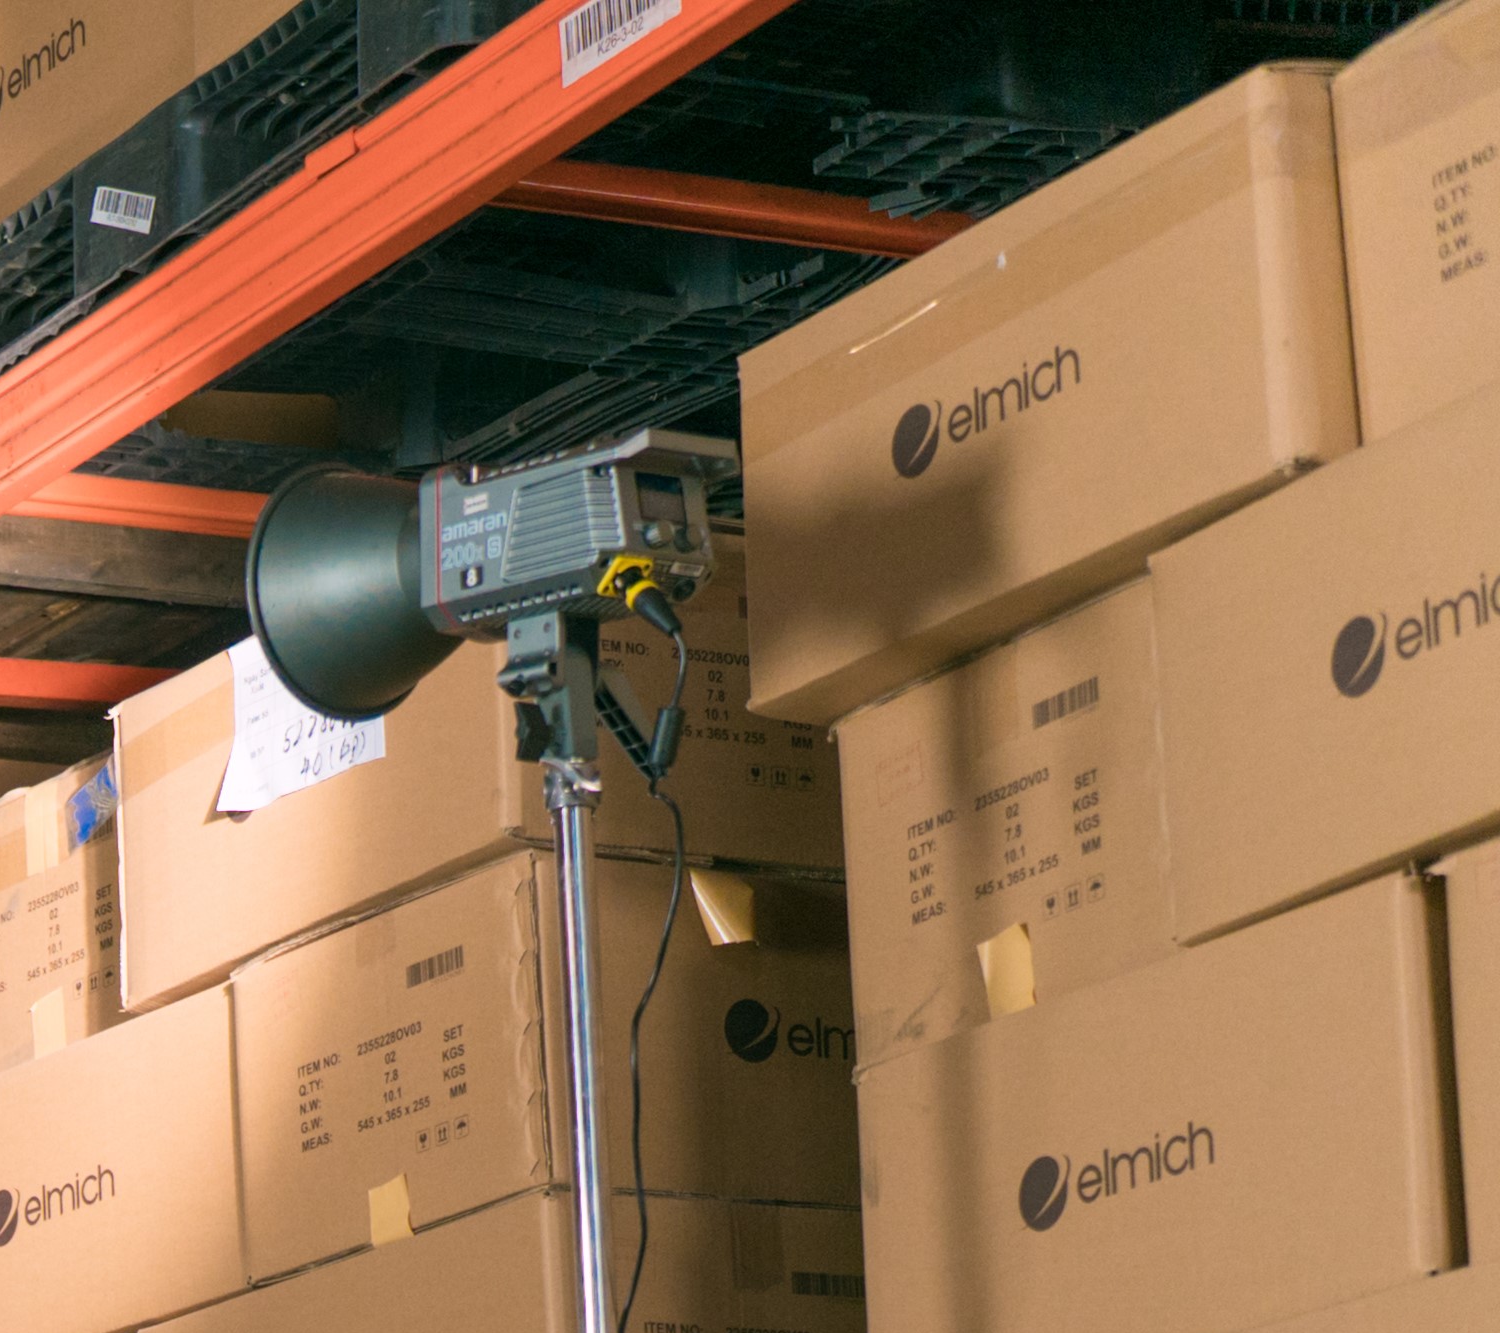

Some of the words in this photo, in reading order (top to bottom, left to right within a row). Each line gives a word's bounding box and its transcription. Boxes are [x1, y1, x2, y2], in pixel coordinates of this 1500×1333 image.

[8, 18, 86, 98] elmich
[597, 16, 644, 57] K26-3-02
[948, 346, 1080, 443] elmich
[441, 511, 507, 543] amaran
[297, 1060, 321, 1079] ITEM
[323, 1053, 341, 1069] NO:
[298, 1079, 324, 1097] Q.TY:
[384, 1051, 396, 1064] 02
[443, 1024, 464, 1042] SET
[300, 1099, 322, 1115] N.W:
[384, 1069, 398, 1084] 7.8
[442, 1044, 465, 1062] KGS
[300, 1117, 323, 1134] G.W:
[383, 1088, 402, 1104] 10.1
[443, 1063, 466, 1081] KGS
[302, 1133, 332, 1152] MEAS:
[357, 1116, 375, 1132] 545
[385, 1106, 402, 1122] 365
[412, 1096, 431, 1112] 255
[449, 1082, 467, 1098] MM
[24, 1164, 115, 1226] elmich
[1077, 1122, 1214, 1203] elmich
